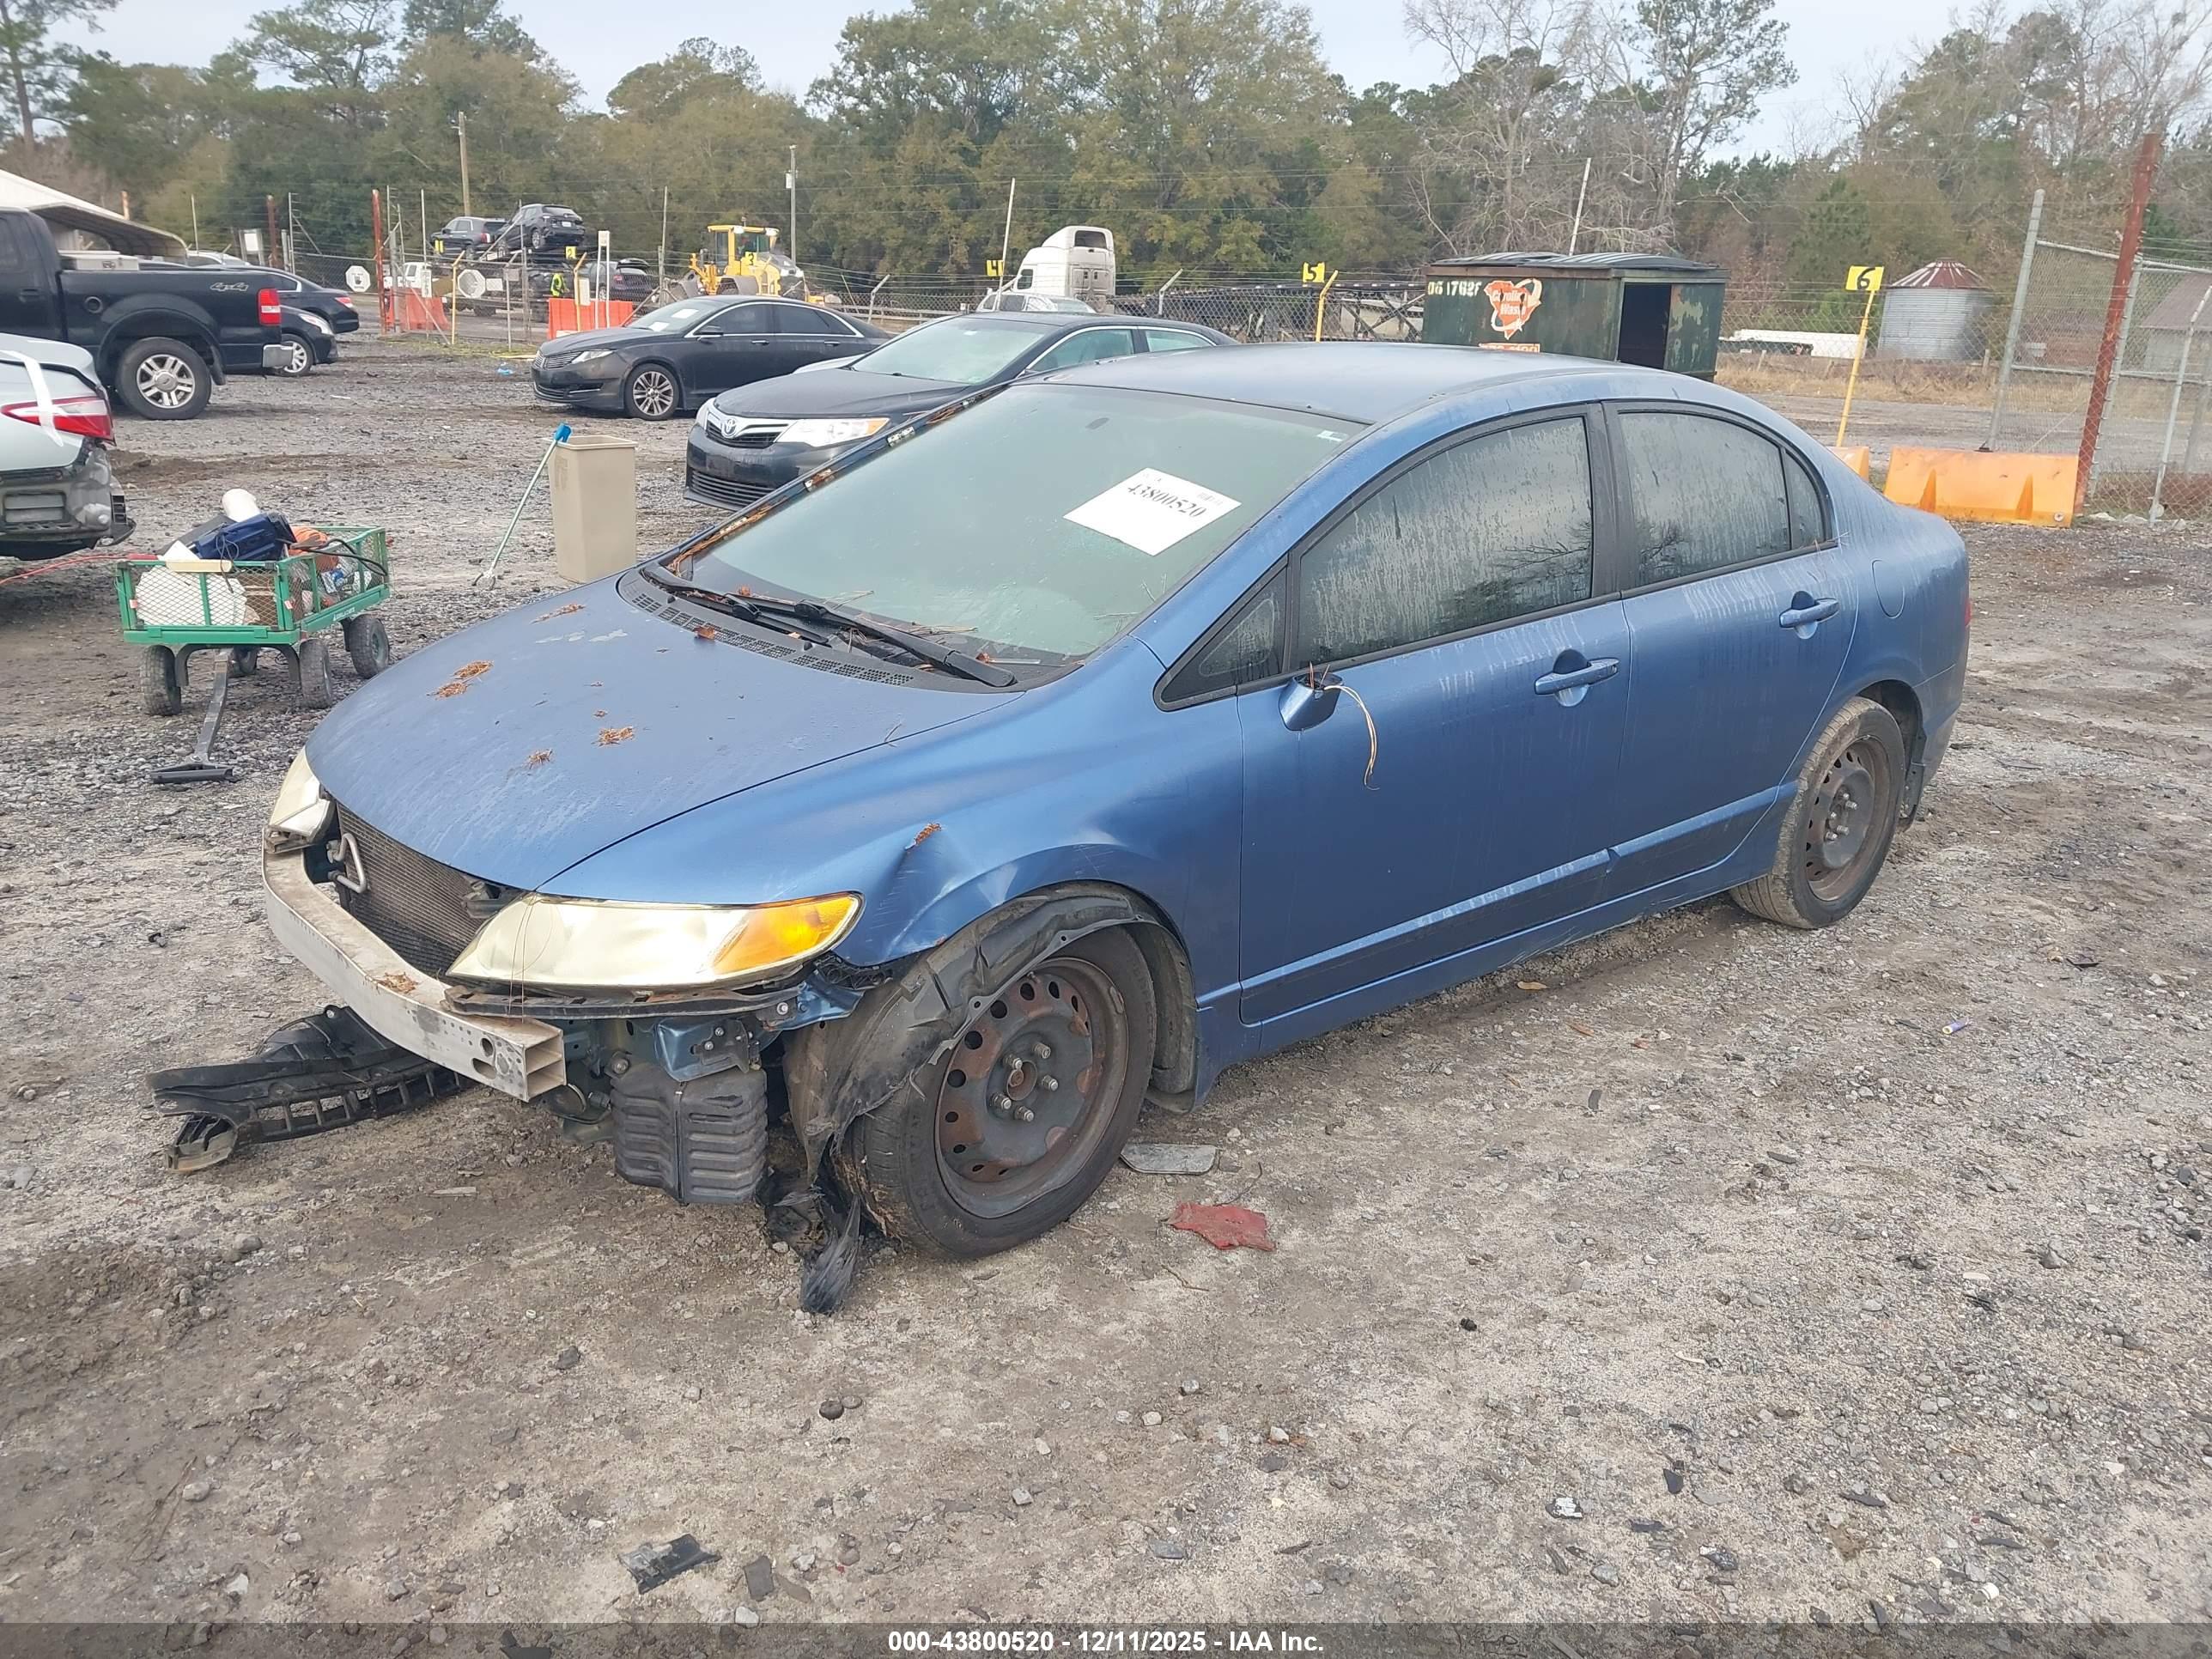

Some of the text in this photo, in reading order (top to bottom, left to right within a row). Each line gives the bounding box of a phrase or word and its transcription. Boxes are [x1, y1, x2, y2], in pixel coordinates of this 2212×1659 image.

[748, 252, 754, 265] 3
[991, 260, 999, 276] 4
[1305, 261, 1317, 281] 5
[1856, 267, 1875, 290] 6
[1127, 483, 1207, 517] 43800520
